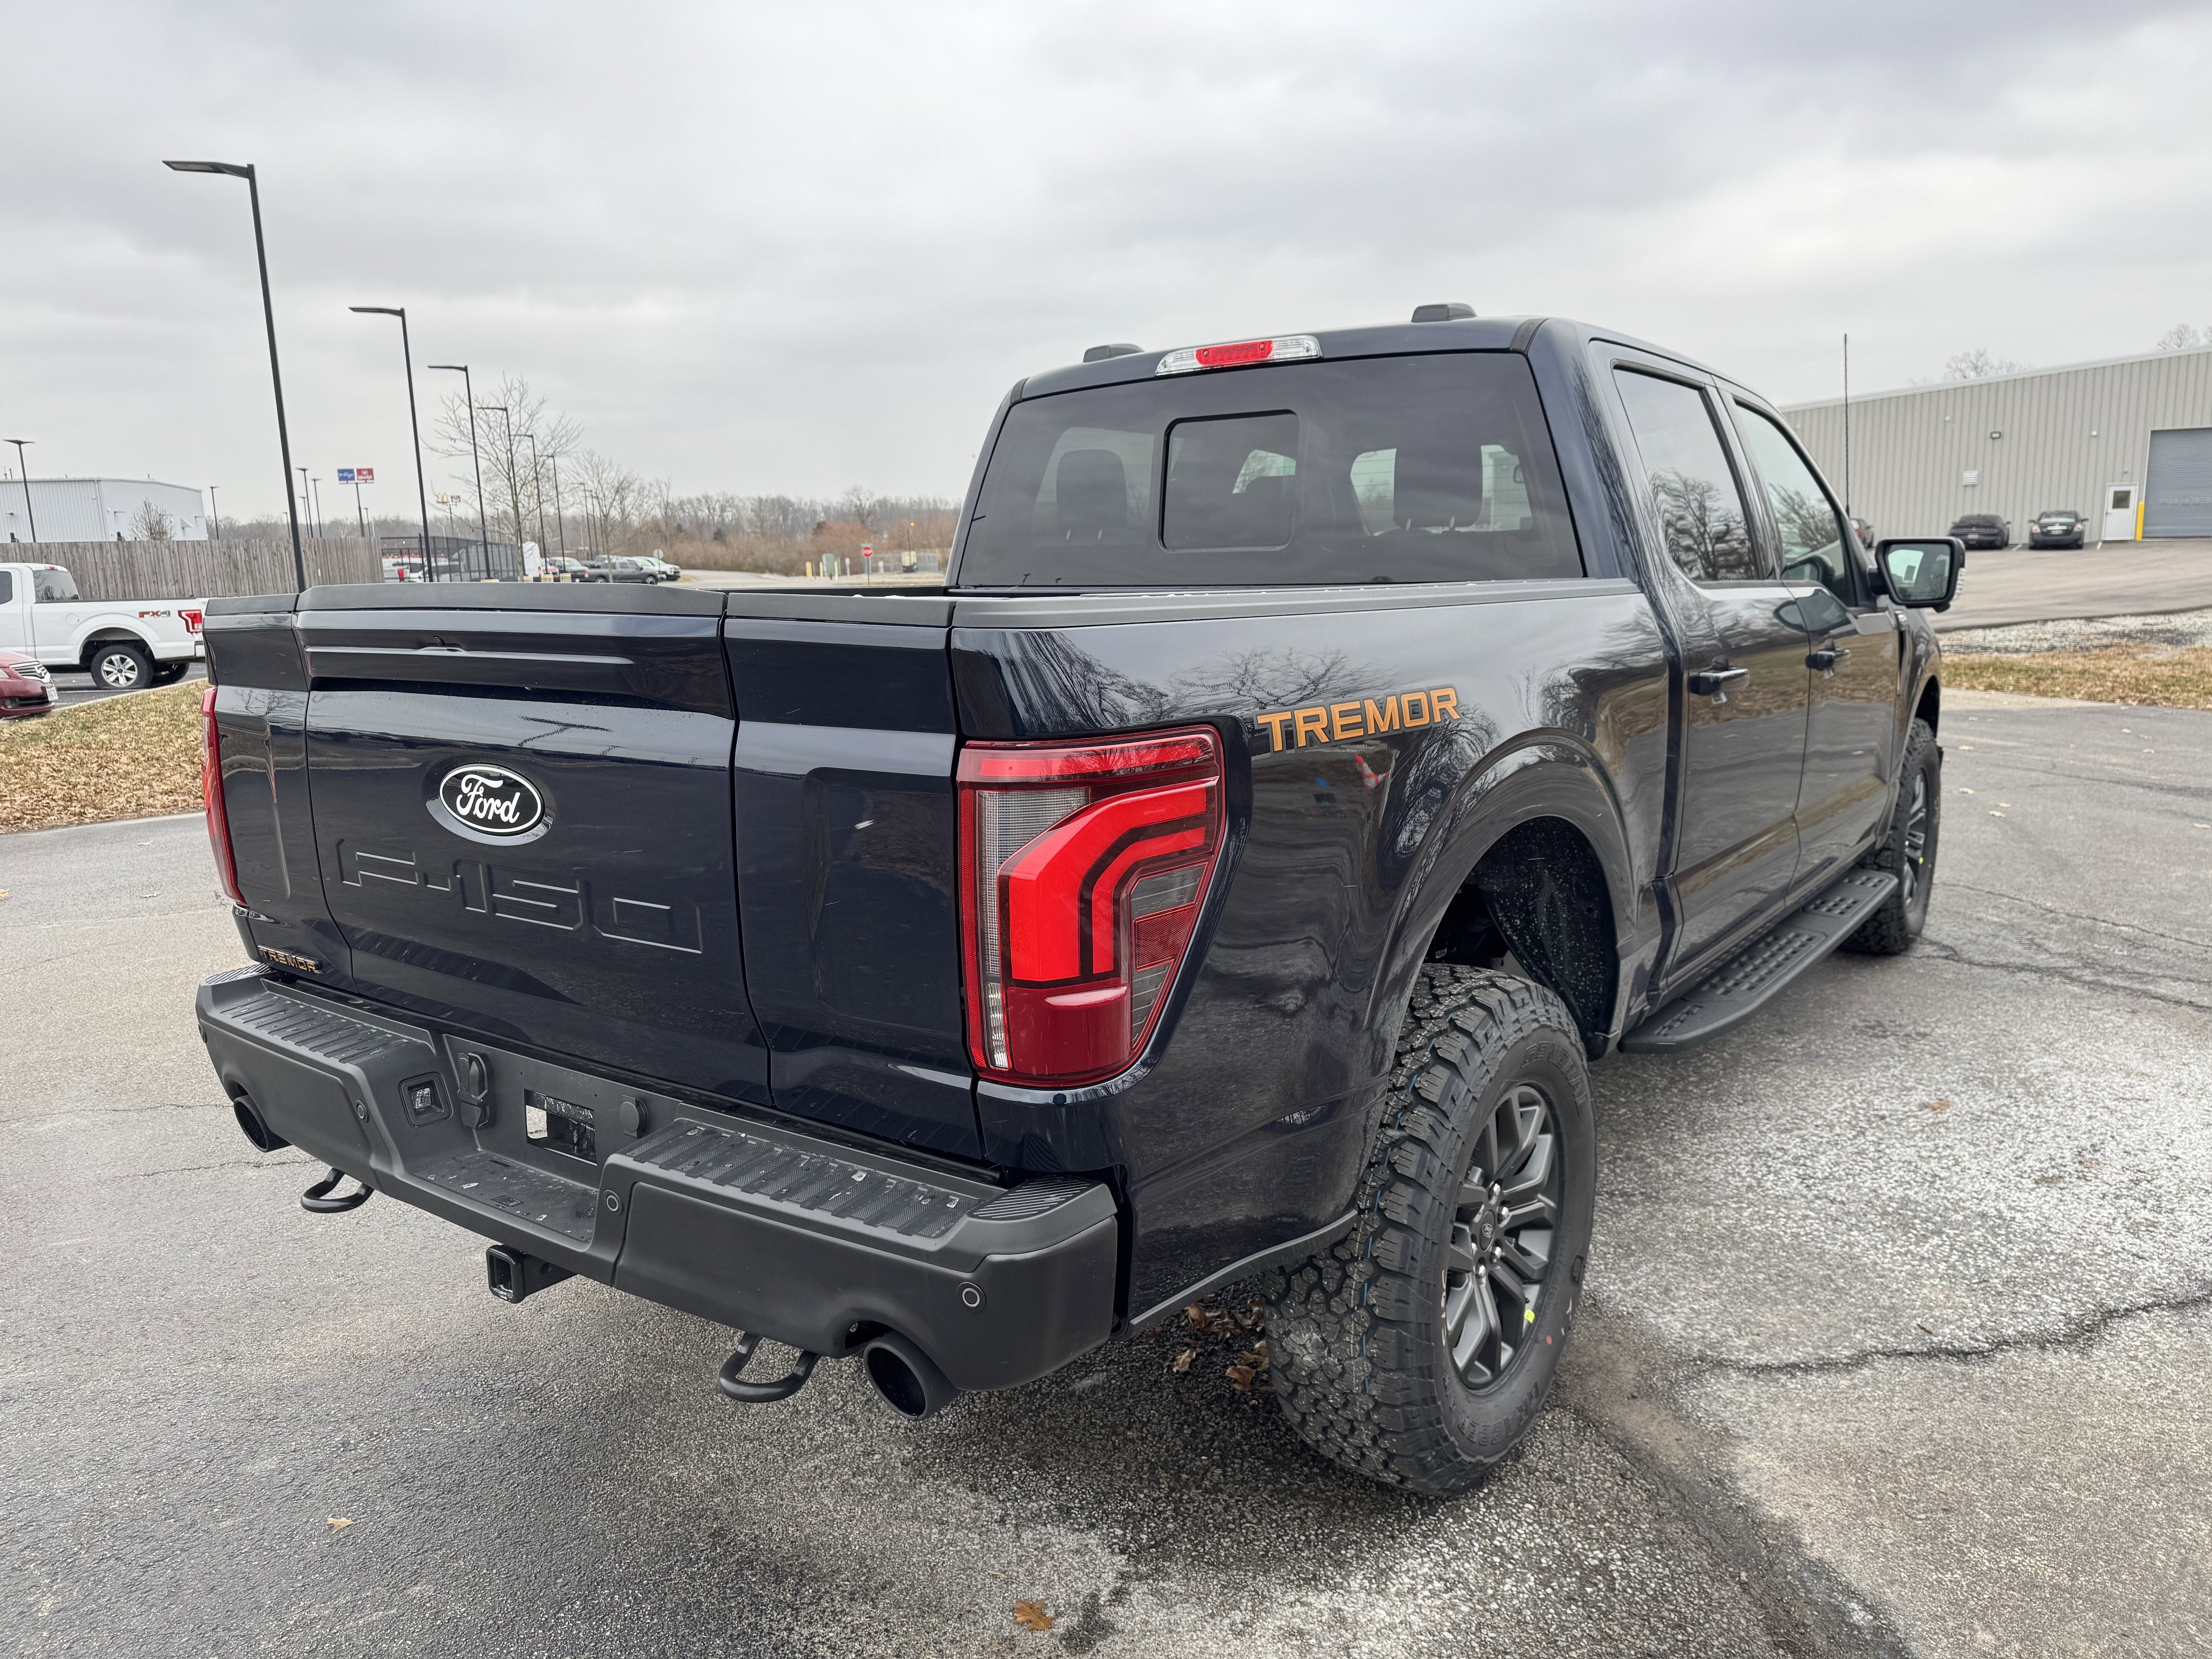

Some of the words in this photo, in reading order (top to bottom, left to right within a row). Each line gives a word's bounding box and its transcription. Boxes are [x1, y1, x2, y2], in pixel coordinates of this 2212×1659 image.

[1257, 687, 1461, 752] TREMOR
[455, 773, 521, 824] Ford
[336, 838, 703, 953] F-150
[258, 945, 323, 974] TREMOR
[1521, 1040, 1587, 1117] GENERAL
